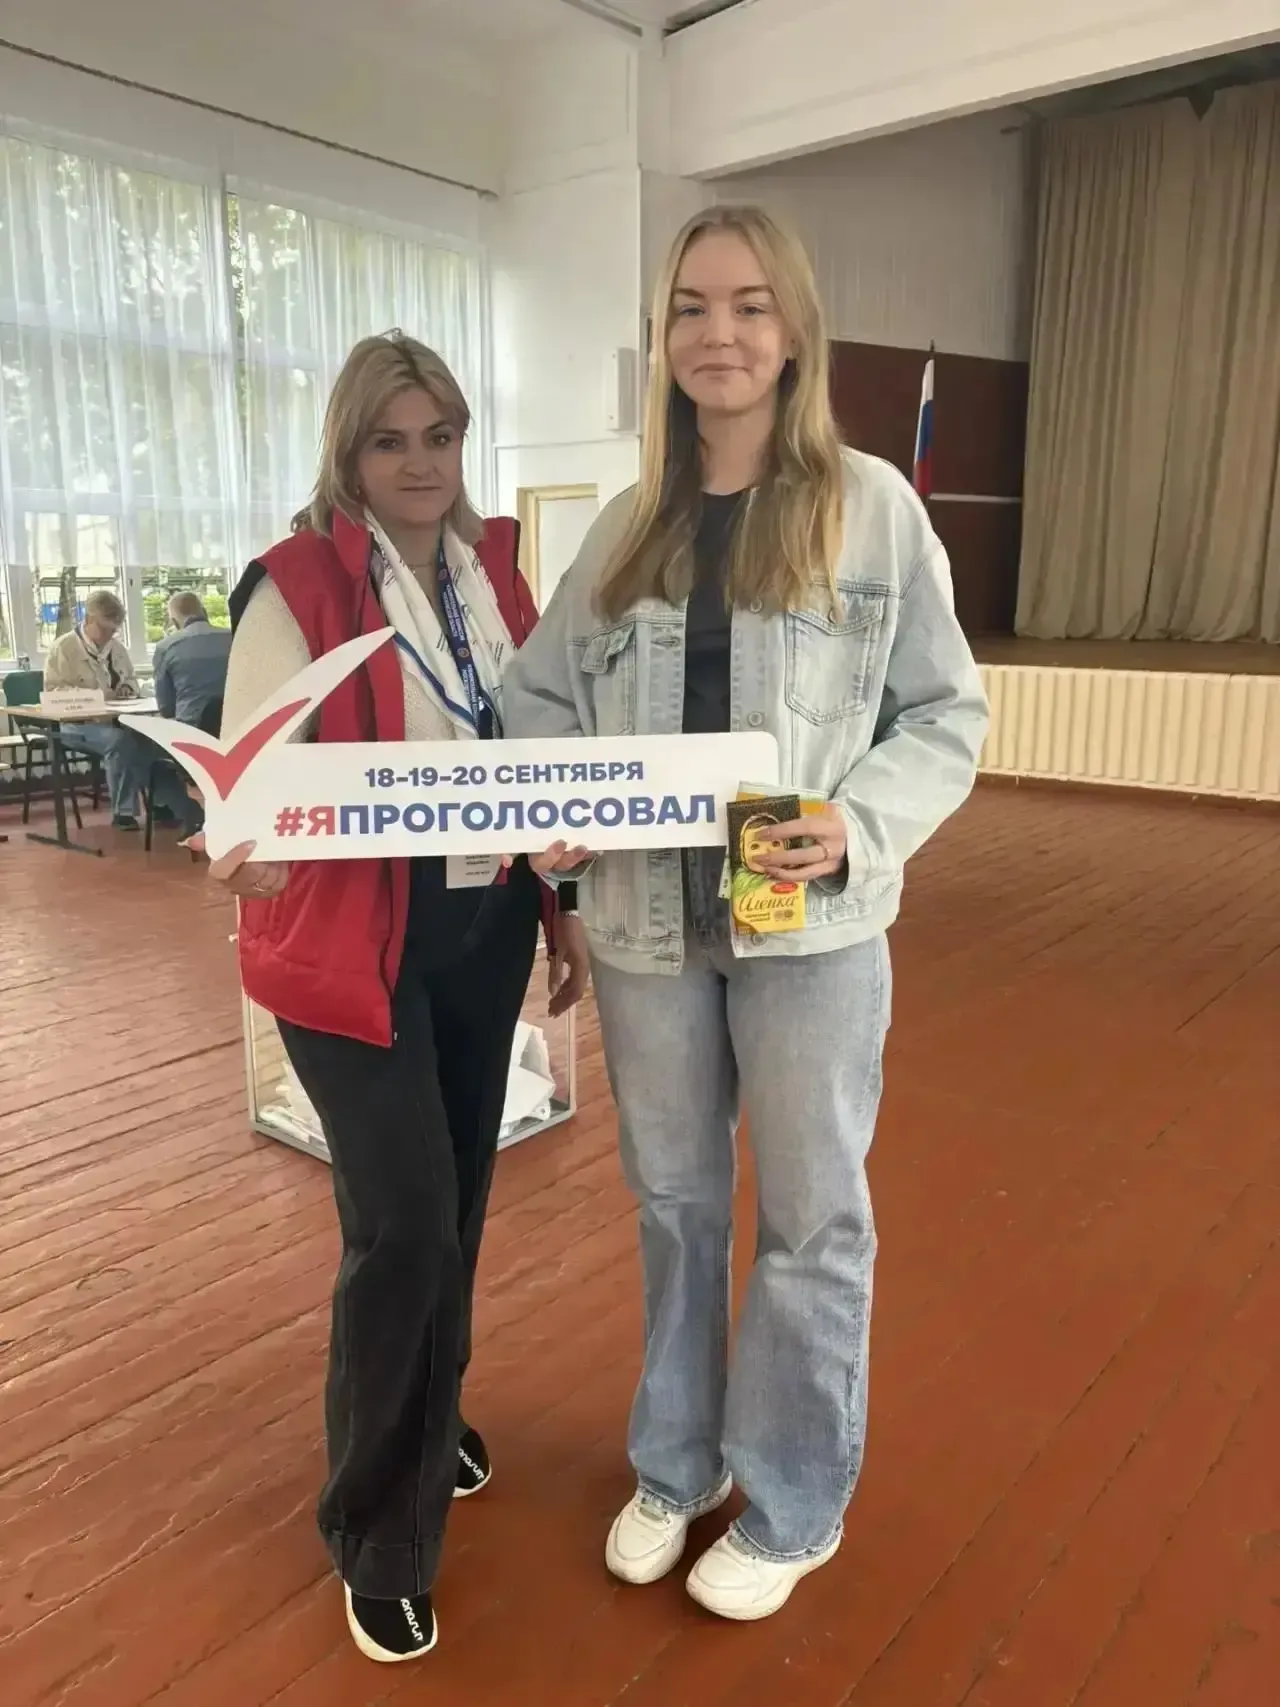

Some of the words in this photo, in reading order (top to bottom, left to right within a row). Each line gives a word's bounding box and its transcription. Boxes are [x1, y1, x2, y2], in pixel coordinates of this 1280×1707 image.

[365, 766, 486, 787] 18-19-20
[494, 761, 644, 784] СЕНТЯБРЯ
[274, 794, 716, 837] #ЯПРОГОЛОСОВАЛ
